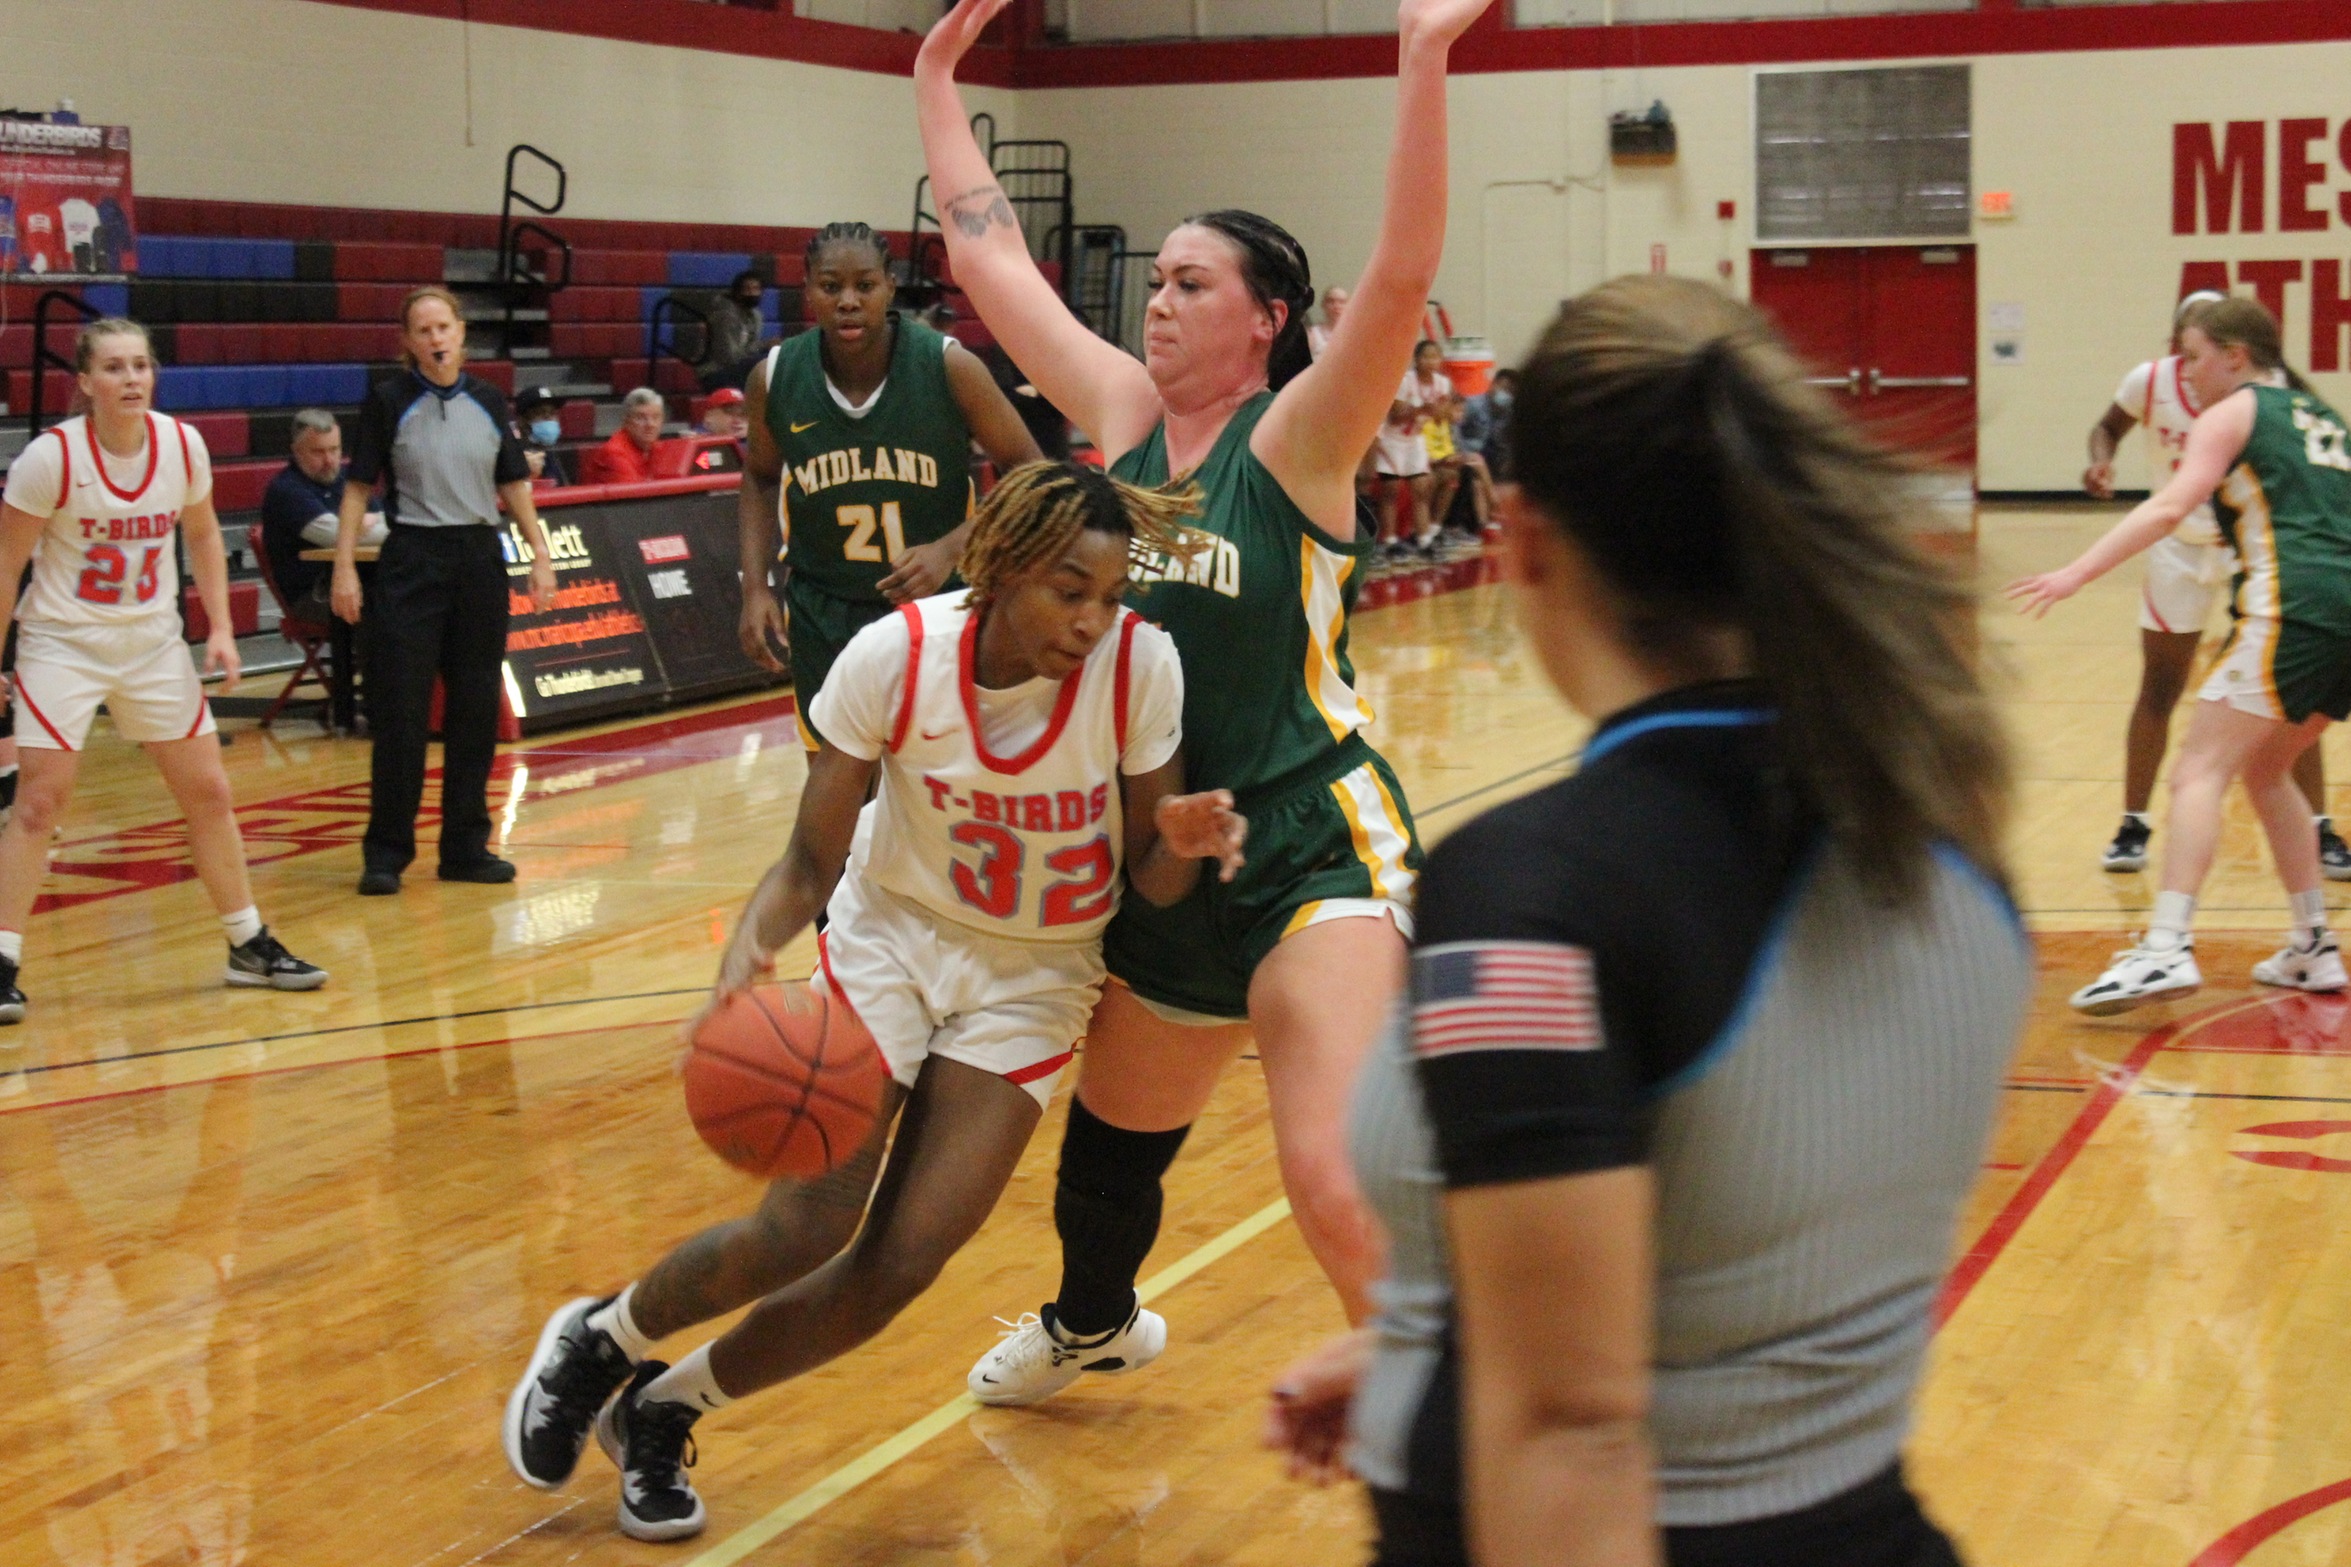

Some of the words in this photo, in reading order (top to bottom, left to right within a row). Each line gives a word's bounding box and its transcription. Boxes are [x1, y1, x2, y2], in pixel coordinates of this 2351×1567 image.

[2172, 117, 2351, 236] ME
[794, 446, 938, 496] MIDLAND
[510, 518, 589, 563] folett
[836, 501, 906, 564] 21
[923, 773, 1109, 833] T-BIRDS
[948, 820, 1115, 928] 32
